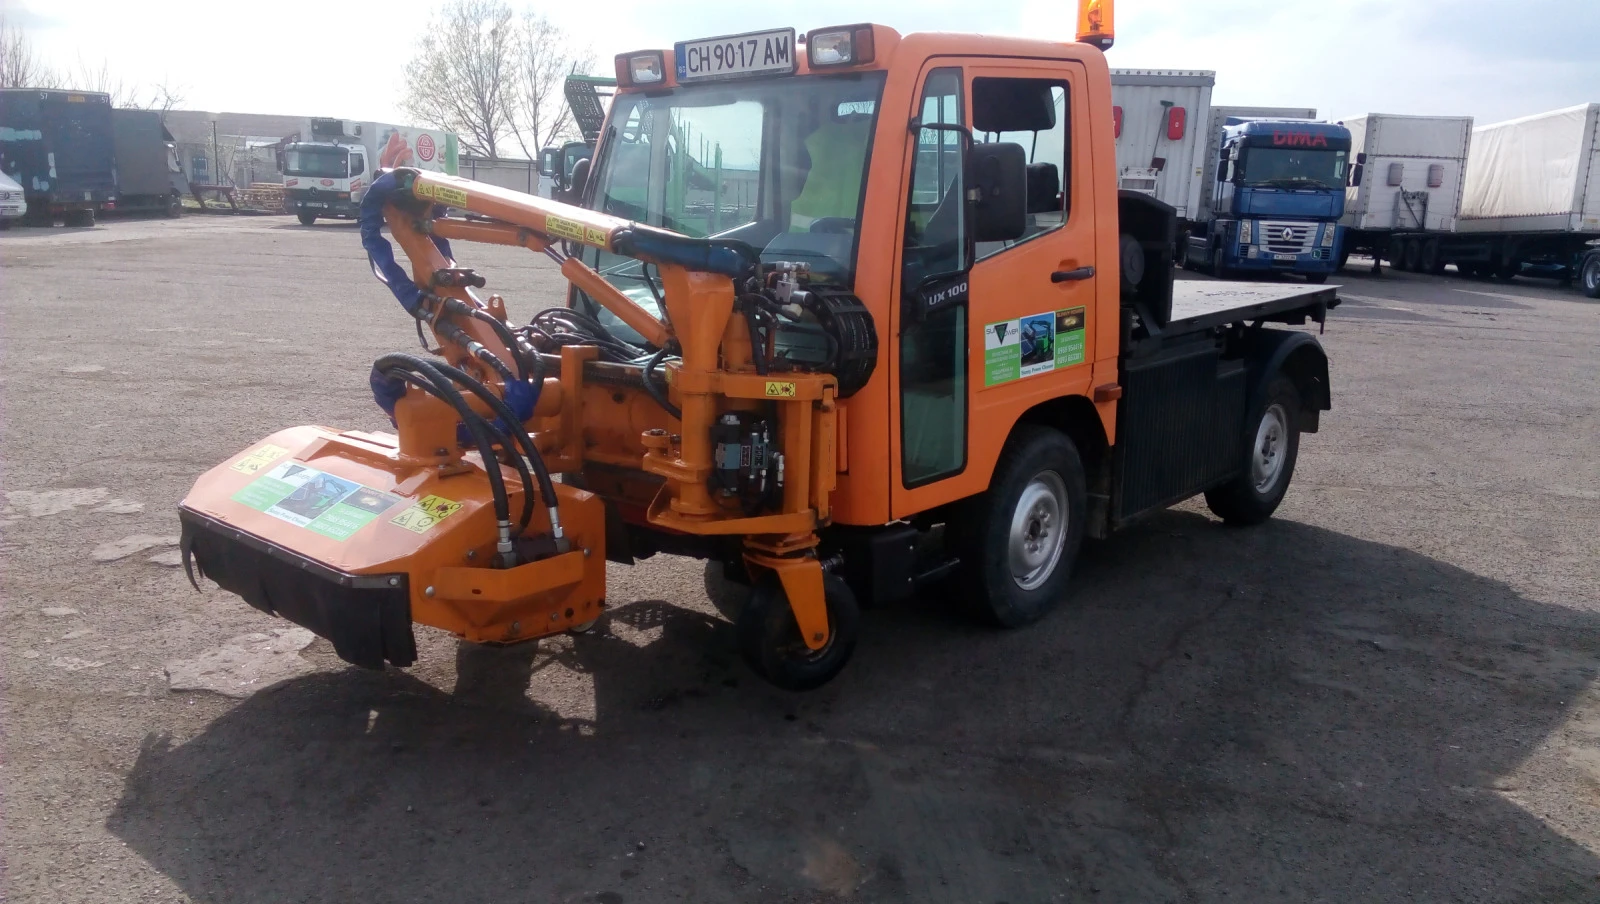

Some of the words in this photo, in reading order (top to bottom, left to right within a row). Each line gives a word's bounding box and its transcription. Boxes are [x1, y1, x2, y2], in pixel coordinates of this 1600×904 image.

[688, 46, 711, 73] CH
[713, 39, 758, 70] 9017
[763, 35, 789, 66] AM
[40, 92, 48, 100] 57
[1273, 130, 1327, 147] DIMA
[928, 291, 945, 305] UX
[947, 282, 968, 298] 100
